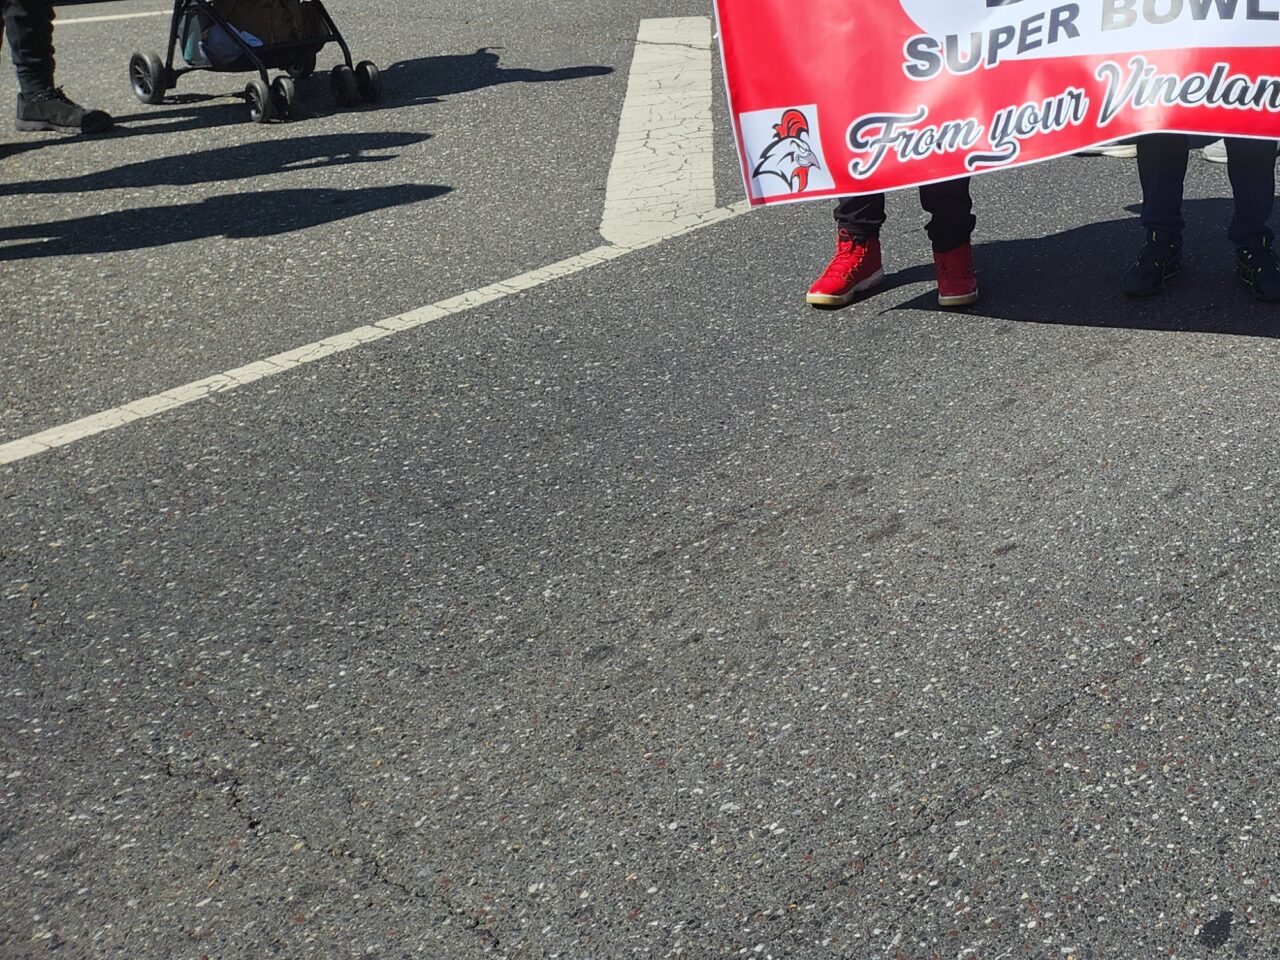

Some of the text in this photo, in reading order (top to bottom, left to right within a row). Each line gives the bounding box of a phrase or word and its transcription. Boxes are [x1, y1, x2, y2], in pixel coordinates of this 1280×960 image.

[902, 2, 1082, 80] SUPER
[847, 106, 982, 177] From
[966, 87, 1088, 171] your
